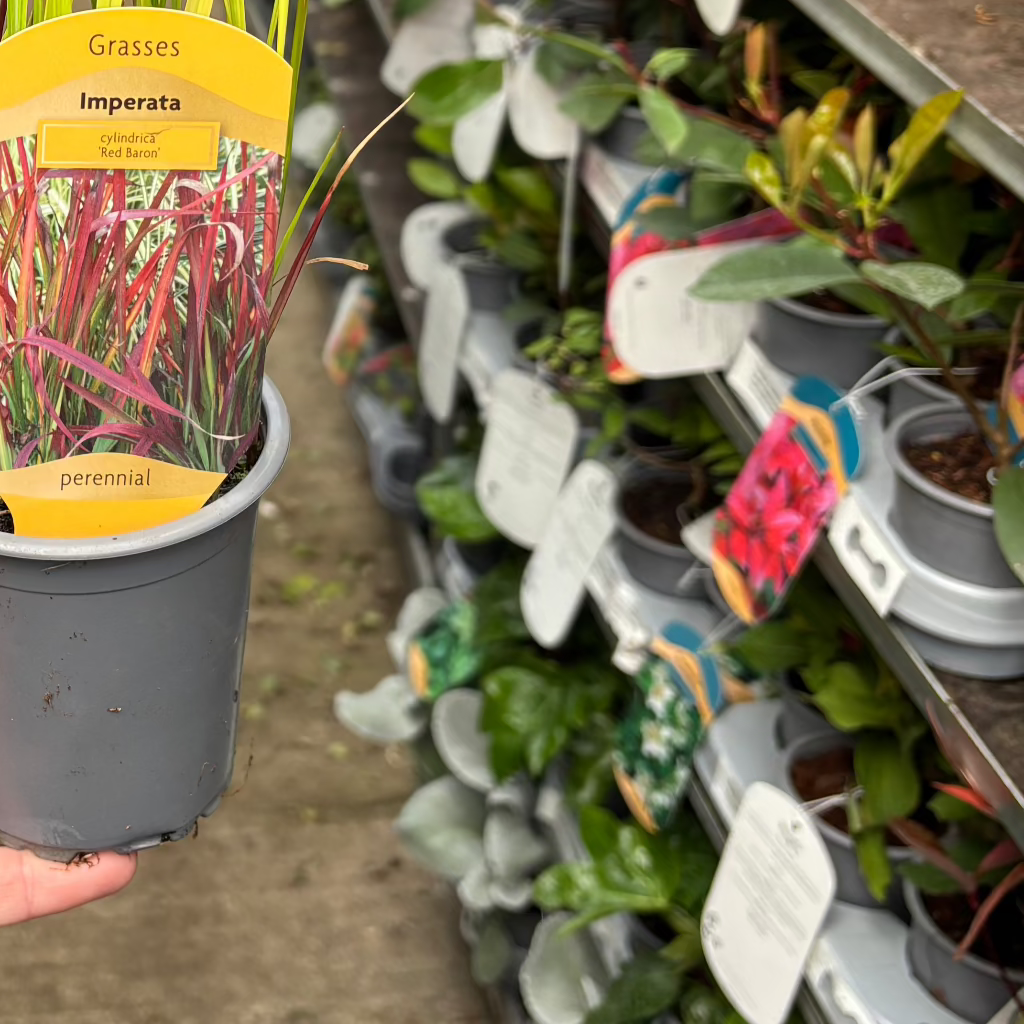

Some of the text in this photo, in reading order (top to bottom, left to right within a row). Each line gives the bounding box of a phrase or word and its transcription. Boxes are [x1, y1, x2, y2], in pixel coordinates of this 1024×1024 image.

[88, 33, 180, 57] Grasses
[80, 92, 181, 116] Imperata
[100, 131, 156, 146] cylindrica
[98, 146, 161, 158] 'Red Baron'
[60, 467, 151, 491] perennial
